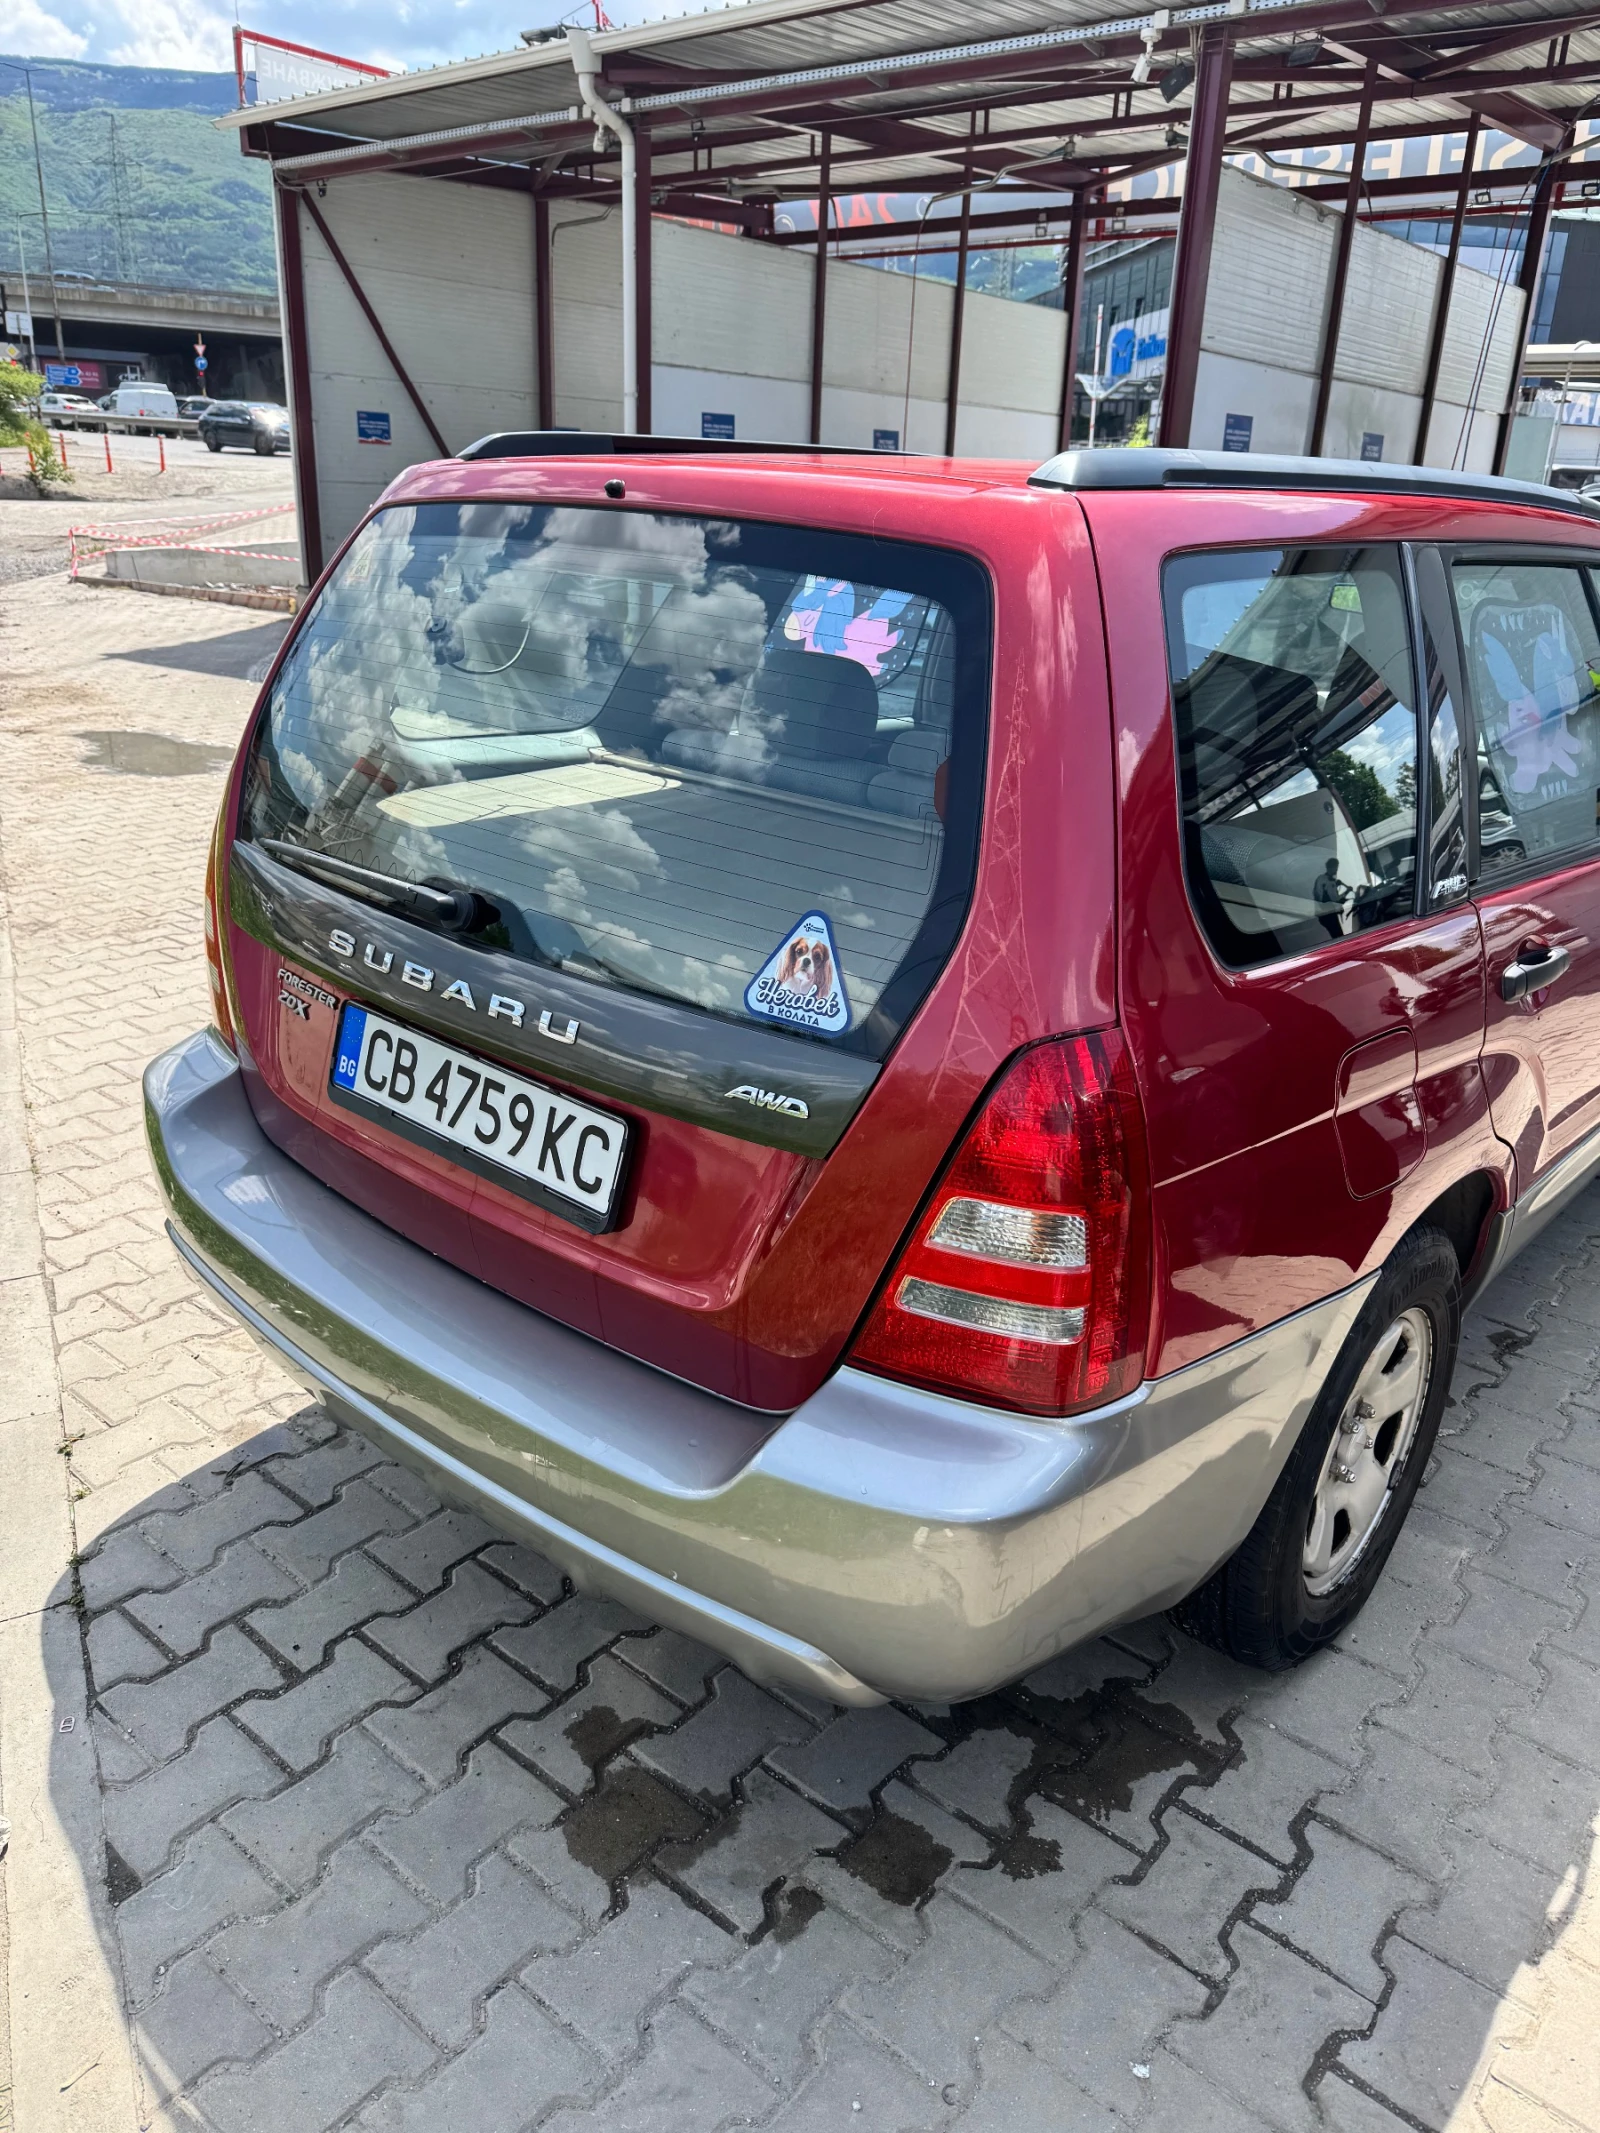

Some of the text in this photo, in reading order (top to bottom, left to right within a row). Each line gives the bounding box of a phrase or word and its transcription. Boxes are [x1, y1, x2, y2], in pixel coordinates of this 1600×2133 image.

[277, 968, 337, 1010] FORESTER
[328, 928, 581, 1045] SUBARU
[777, 1007, 820, 1026] КОЛАТА
[338, 1054, 357, 1077] BG
[425, 1059, 535, 1157] 4759
[724, 1085, 809, 1119] AWD
